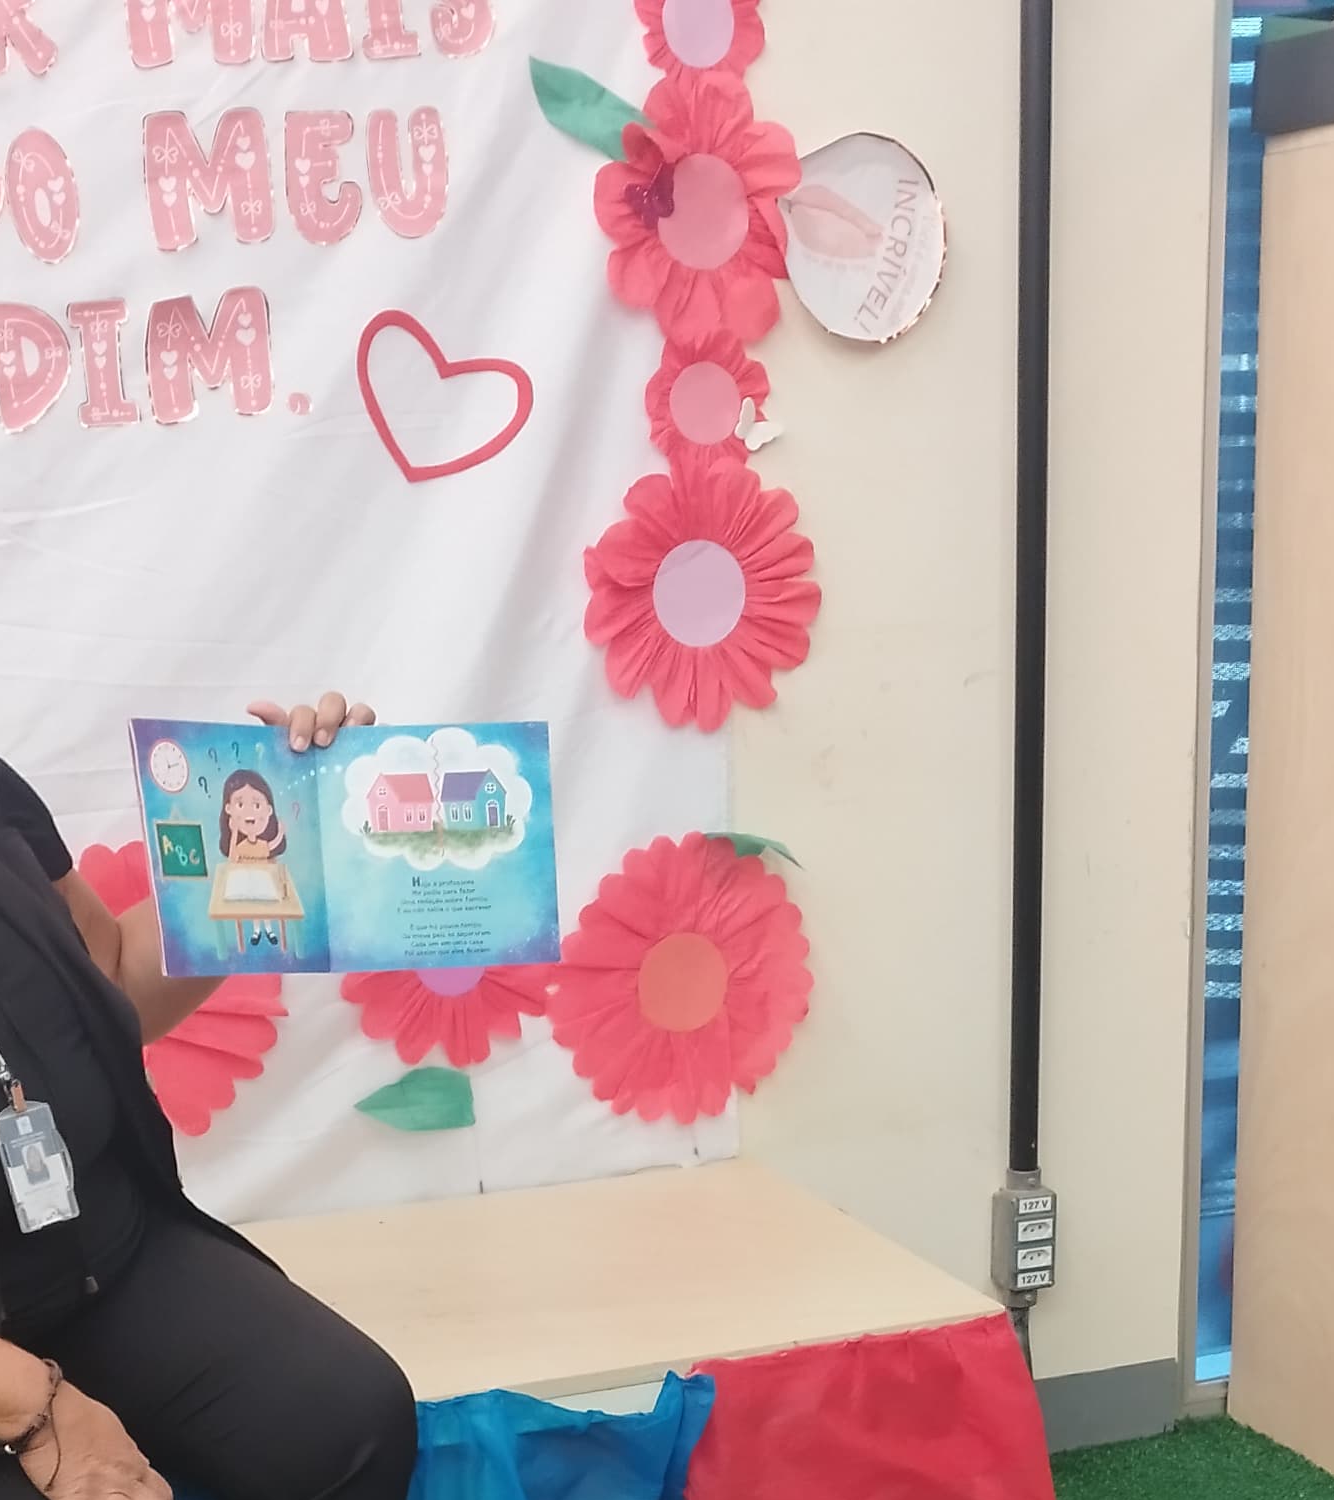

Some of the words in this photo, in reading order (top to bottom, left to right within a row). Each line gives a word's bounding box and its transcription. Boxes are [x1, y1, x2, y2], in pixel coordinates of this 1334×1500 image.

[142, 104, 451, 251] MEU
[1023, 1200, 1040, 1211] 127
[1041, 1199, 1049, 1209] V
[1021, 1275, 1038, 1285] 127
[1039, 1273, 1047, 1283] V
